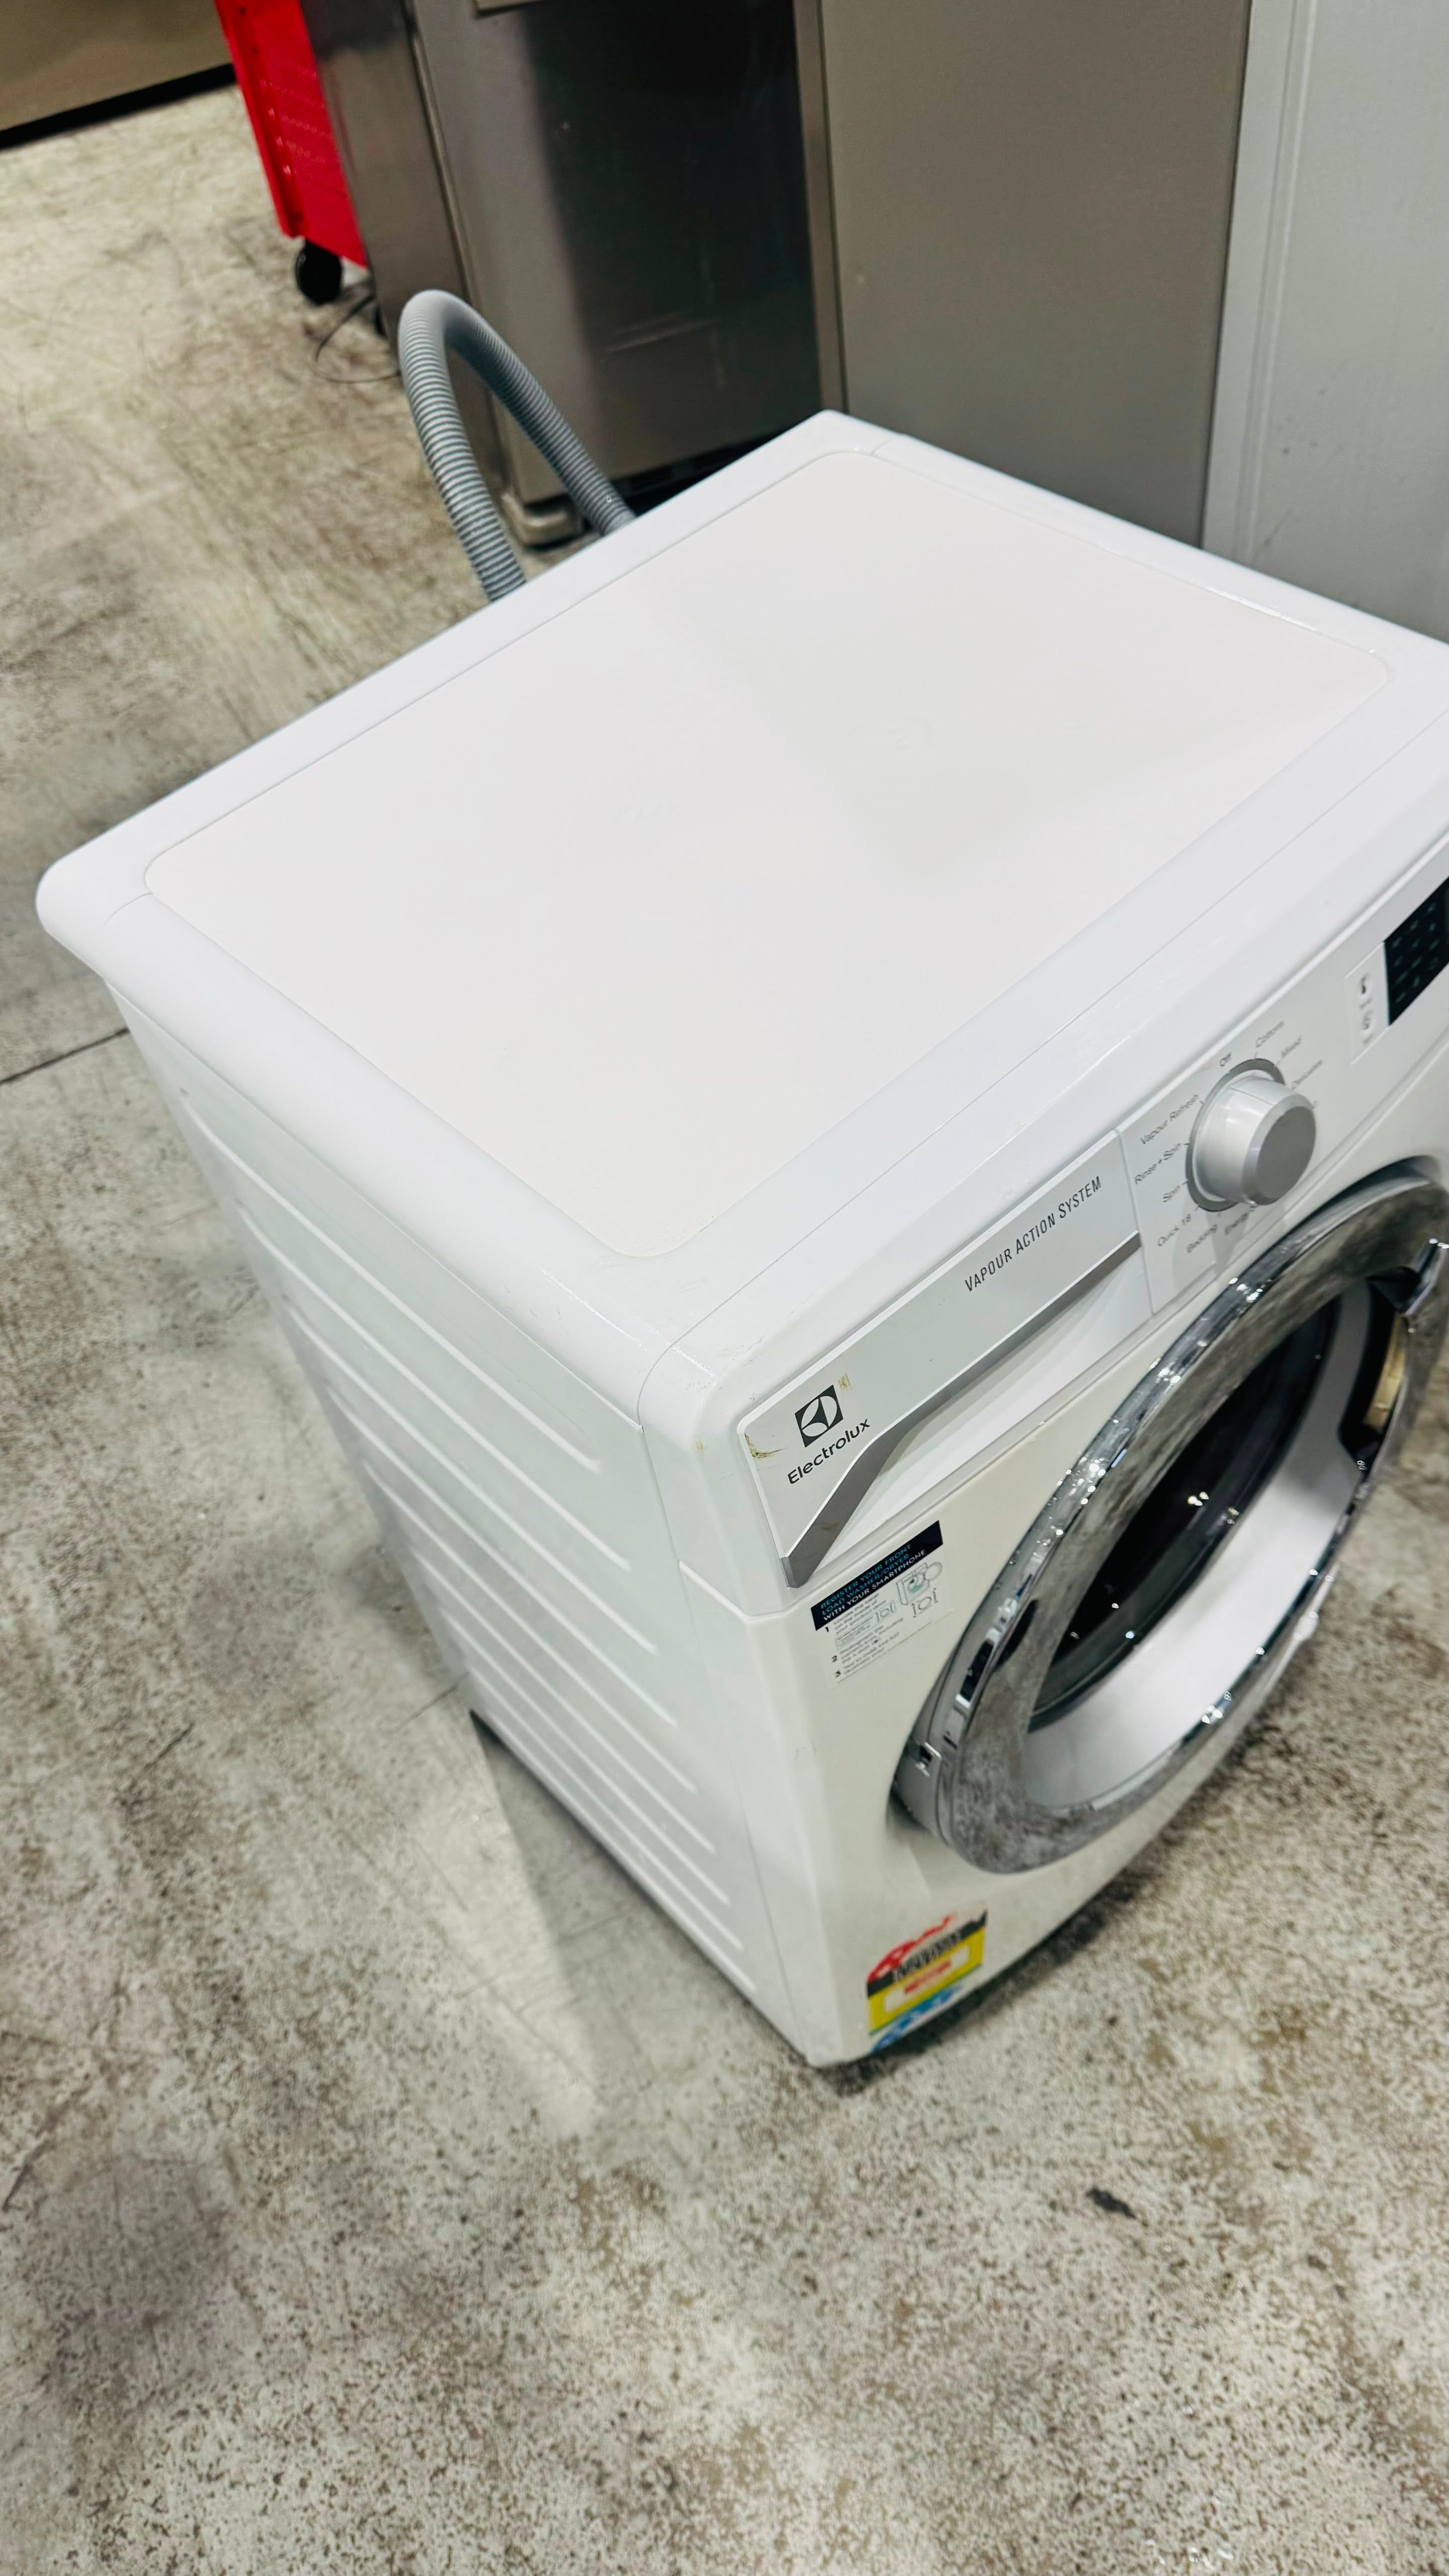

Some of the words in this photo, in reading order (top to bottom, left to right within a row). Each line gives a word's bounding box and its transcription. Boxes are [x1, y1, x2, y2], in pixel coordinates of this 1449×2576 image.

[1220, 1052, 1231, 1067] Off
[1140, 1119, 1168, 1145] Vapour
[1163, 1185, 1180, 1202] Spin
[964, 1248, 1012, 1292] VAPOUR
[1016, 1213, 1056, 1254] ACTION
[1058, 1175, 1101, 1219] SYSTEM
[787, 1418, 870, 1484] Electrolux
[821, 1580, 858, 1609] REGISTER
[860, 1564, 882, 1583] YOUR
[884, 1543, 911, 1566] FRONT
[822, 1596, 846, 1616] LOAD
[846, 1553, 909, 1599] WASHER/DRYER
[823, 1603, 845, 1623] WITH
[846, 1586, 870, 1607] YOUR
[871, 1549, 925, 1590] SMARTPHONE
[825, 1625, 829, 1633] 1
[831, 1654, 838, 1663] 2
